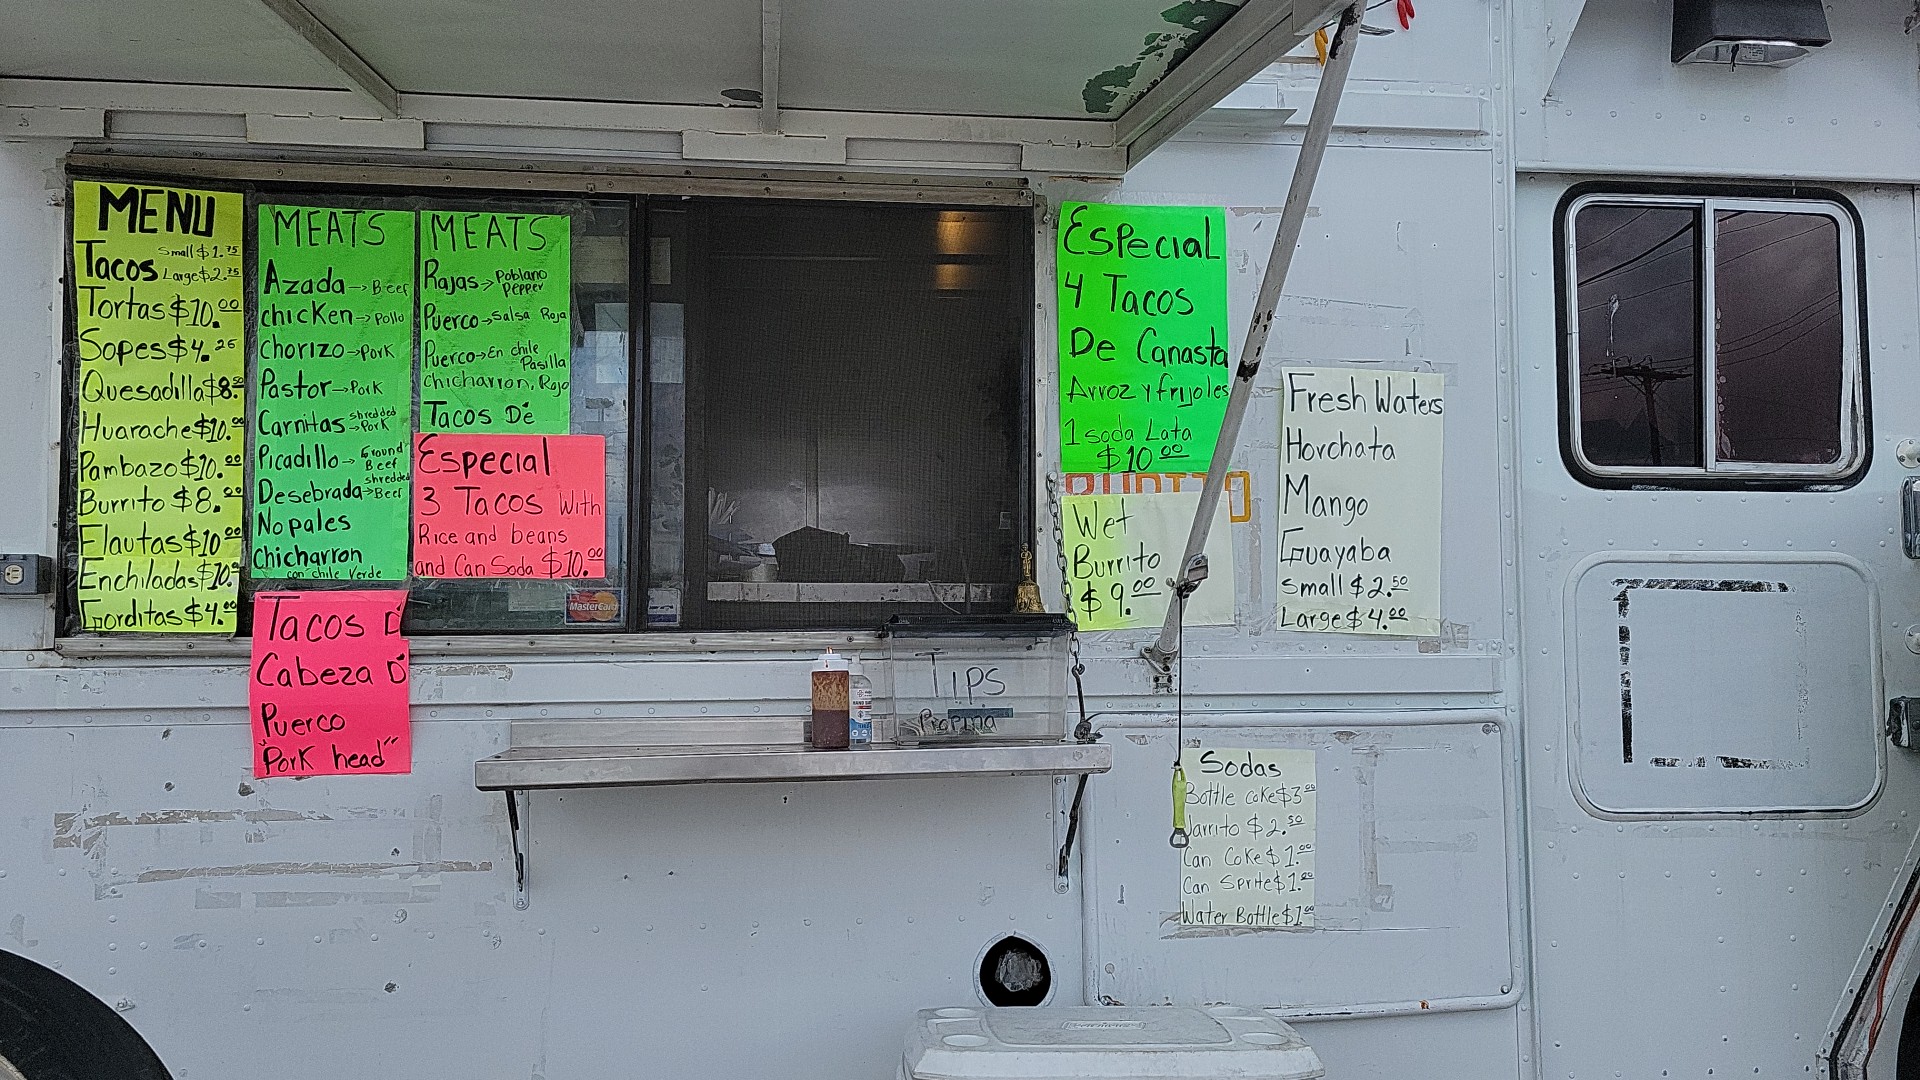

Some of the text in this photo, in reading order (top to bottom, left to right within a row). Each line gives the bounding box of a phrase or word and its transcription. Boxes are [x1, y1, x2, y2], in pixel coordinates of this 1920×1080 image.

[98, 185, 215, 237] MENU
[275, 209, 385, 247] MEATS
[432, 213, 549, 252] MEATS
[76, 240, 158, 281] Tacos
[158, 244, 194, 258] Small
[162, 266, 242, 285] Large $2.75
[264, 259, 409, 297] Azada Beef
[424, 259, 479, 295] Rajas
[78, 286, 242, 328] Tortas $10.00
[1065, 271, 1194, 316] 4 Tacos
[375, 311, 405, 325] Pollo
[424, 302, 479, 331] Puerco
[540, 307, 567, 323] Roja
[80, 328, 167, 366] Sopes
[424, 339, 539, 369] Puerco En chile
[520, 354, 566, 371] Pasilla
[1069, 326, 1228, 368] De Canasta
[82, 369, 204, 402] Quesadilla
[261, 368, 332, 399] Pastor
[1066, 375, 1136, 403] Arroz
[1288, 373, 1443, 415] Fresh Waters
[81, 411, 193, 444] Huarache
[258, 409, 345, 437] Carnitas
[423, 400, 492, 428] Tacos
[1065, 414, 1192, 446] 1 soda Lata
[259, 444, 397, 471] Picadillo Beef
[361, 442, 403, 458] Ground
[418, 433, 550, 479] Especial
[1286, 425, 1396, 464] Horchata
[80, 448, 242, 482] Pambazo $10.00
[78, 485, 243, 516] Burrito $8.00
[259, 478, 402, 504] Desebrada Beef
[421, 486, 601, 516] 3 Tacos With
[1284, 474, 1368, 526] Mango
[419, 523, 567, 545] Rice and beans
[1073, 497, 1134, 540] Wet
[79, 521, 182, 556] Flautas
[1280, 527, 1391, 569] Guayaba
[79, 557, 199, 592] Enchiladas
[287, 565, 382, 579] con chile Verde
[415, 546, 604, 578] and Can Soda $10.00
[1073, 542, 1161, 579] Burrito
[1281, 573, 1343, 597] Small
[80, 598, 183, 632] Gorditas
[260, 595, 365, 642] Tacos
[569, 602, 618, 611] MasterCard
[1281, 607, 1341, 631] Large
[256, 652, 373, 688] Cabeza
[261, 703, 345, 737] Puerco
[1200, 751, 1282, 778] Sodas
[1185, 782, 1235, 806] Bottle
[1183, 814, 1240, 837] Jarrito
[1183, 846, 1211, 868] Can
[1183, 876, 1209, 894] Can
[1220, 872, 1273, 892] Sprite
[1181, 899, 1229, 925] Water
[1236, 905, 1280, 925] Bottle
